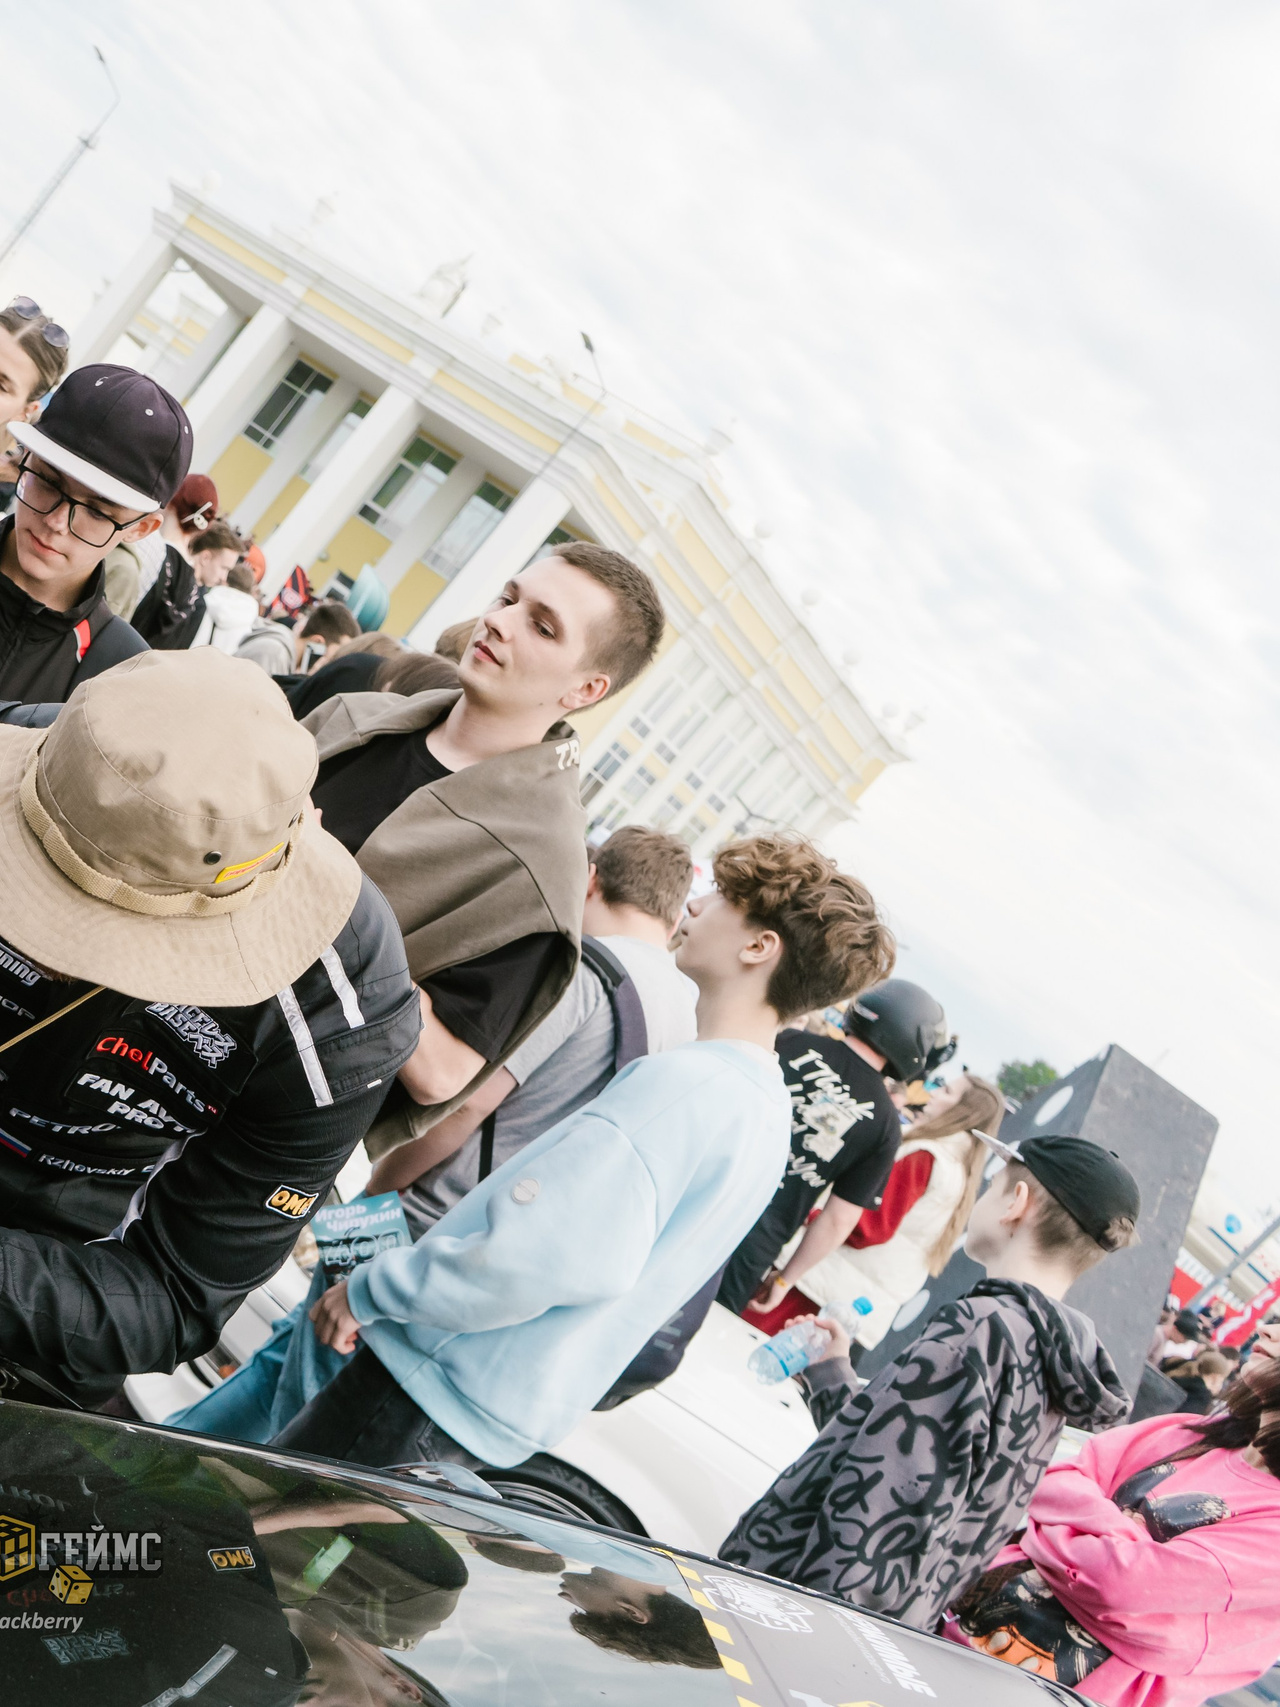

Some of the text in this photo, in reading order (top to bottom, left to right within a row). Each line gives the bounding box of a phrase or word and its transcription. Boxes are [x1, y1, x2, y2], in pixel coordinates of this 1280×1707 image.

[77, 1073, 135, 1101] FAN
[96, 1036, 206, 1113] ChelParts
[9, 1107, 122, 1134] PETRO
[107, 1101, 164, 1129] PRO
[315, 1204, 367, 1223] Игорь
[326, 1207, 401, 1232] Чипухин
